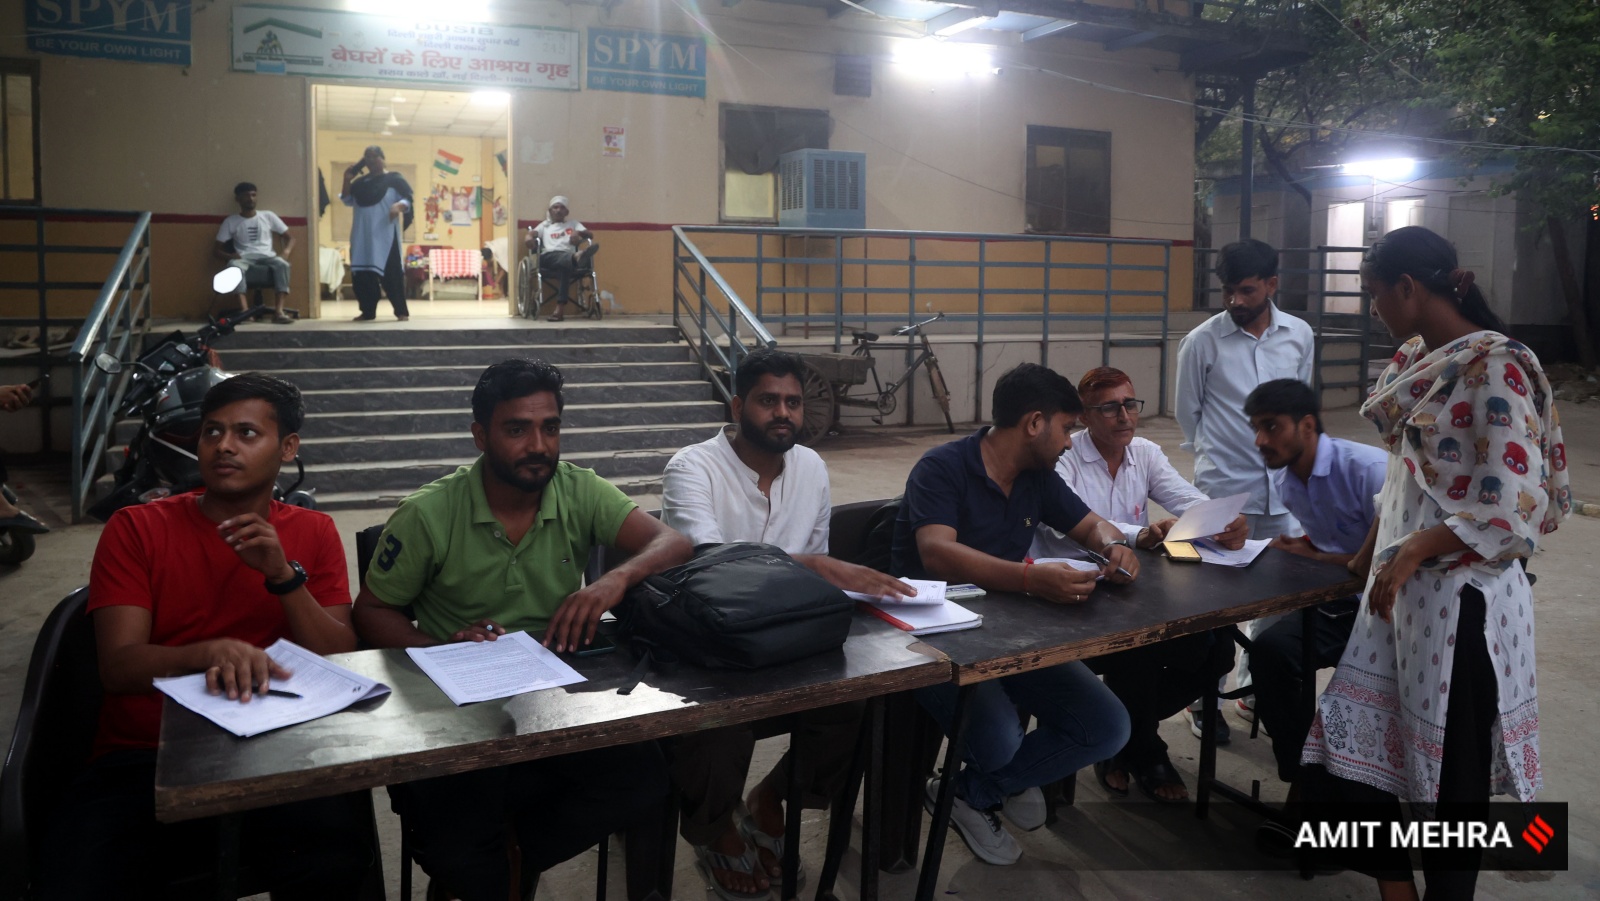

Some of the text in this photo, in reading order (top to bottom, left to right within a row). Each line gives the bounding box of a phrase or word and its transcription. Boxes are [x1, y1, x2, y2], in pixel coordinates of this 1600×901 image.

[37, 0, 180, 34] SPYM
[36, 38, 181, 59] BE YOUR OWN LIGHT
[331, 44, 388, 64] बेघरों
[391, 49, 415, 66] के
[421, 50, 463, 70] लिए
[468, 57, 531, 74] आश्रय
[537, 62, 571, 80] गृह
[594, 35, 699, 71] SPYM
[592, 75, 698, 92] BE YOUR OWN LIGHT
[377, 534, 402, 572] 3
